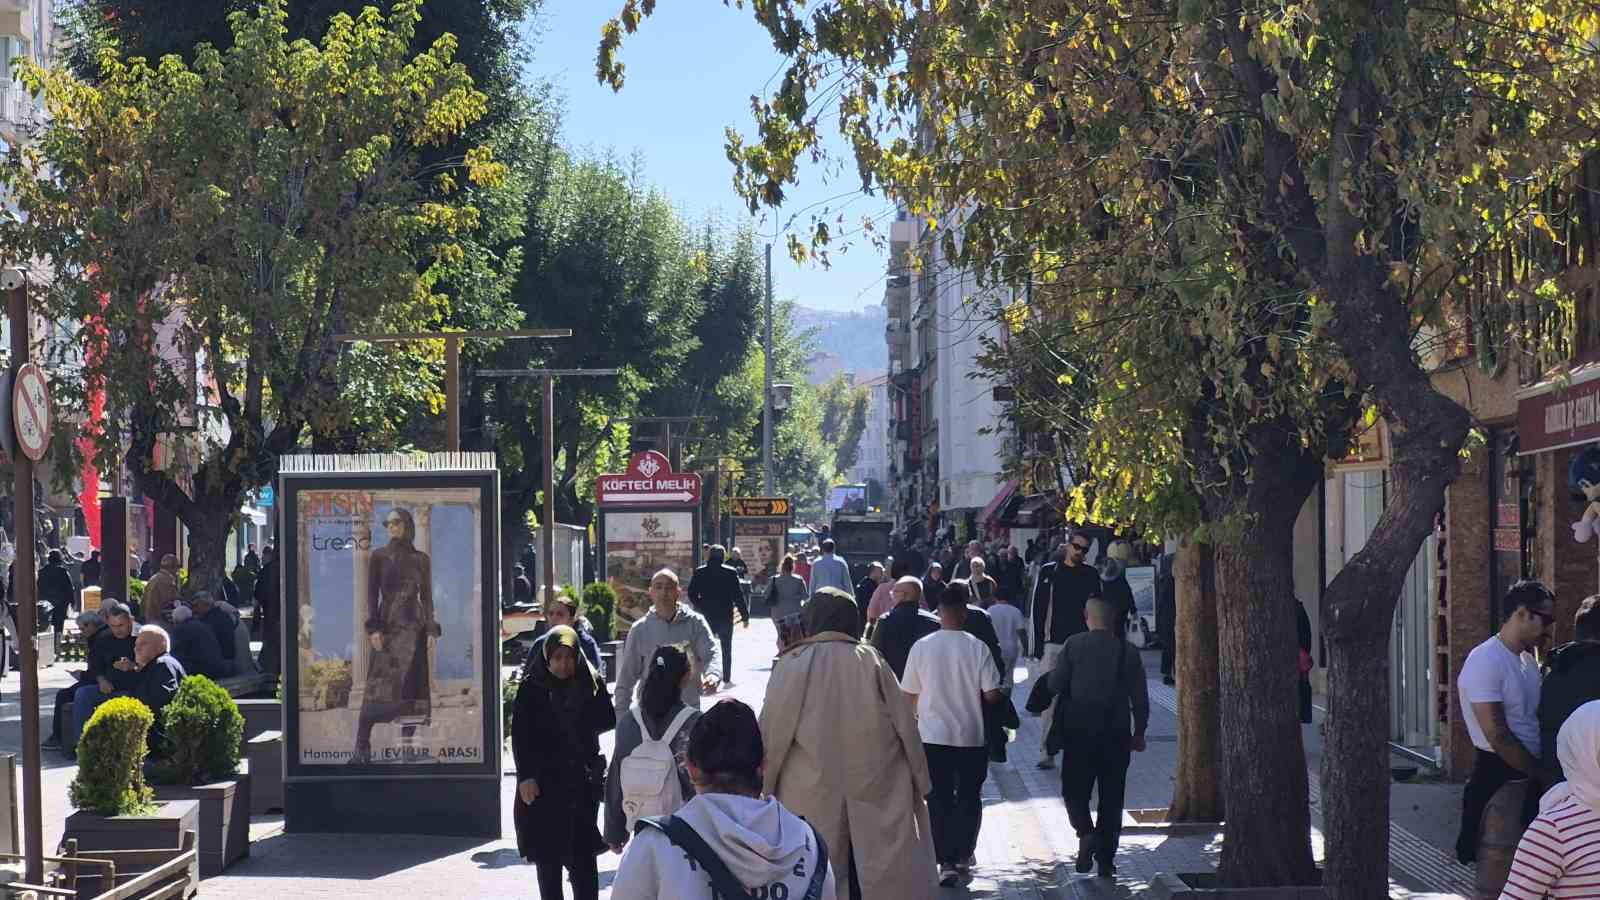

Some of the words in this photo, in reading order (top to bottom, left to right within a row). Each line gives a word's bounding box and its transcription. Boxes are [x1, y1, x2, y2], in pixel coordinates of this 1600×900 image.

[602, 478, 653, 491] KÖFTECİ
[656, 477, 696, 490] MELİH
[312, 532, 371, 551] trend
